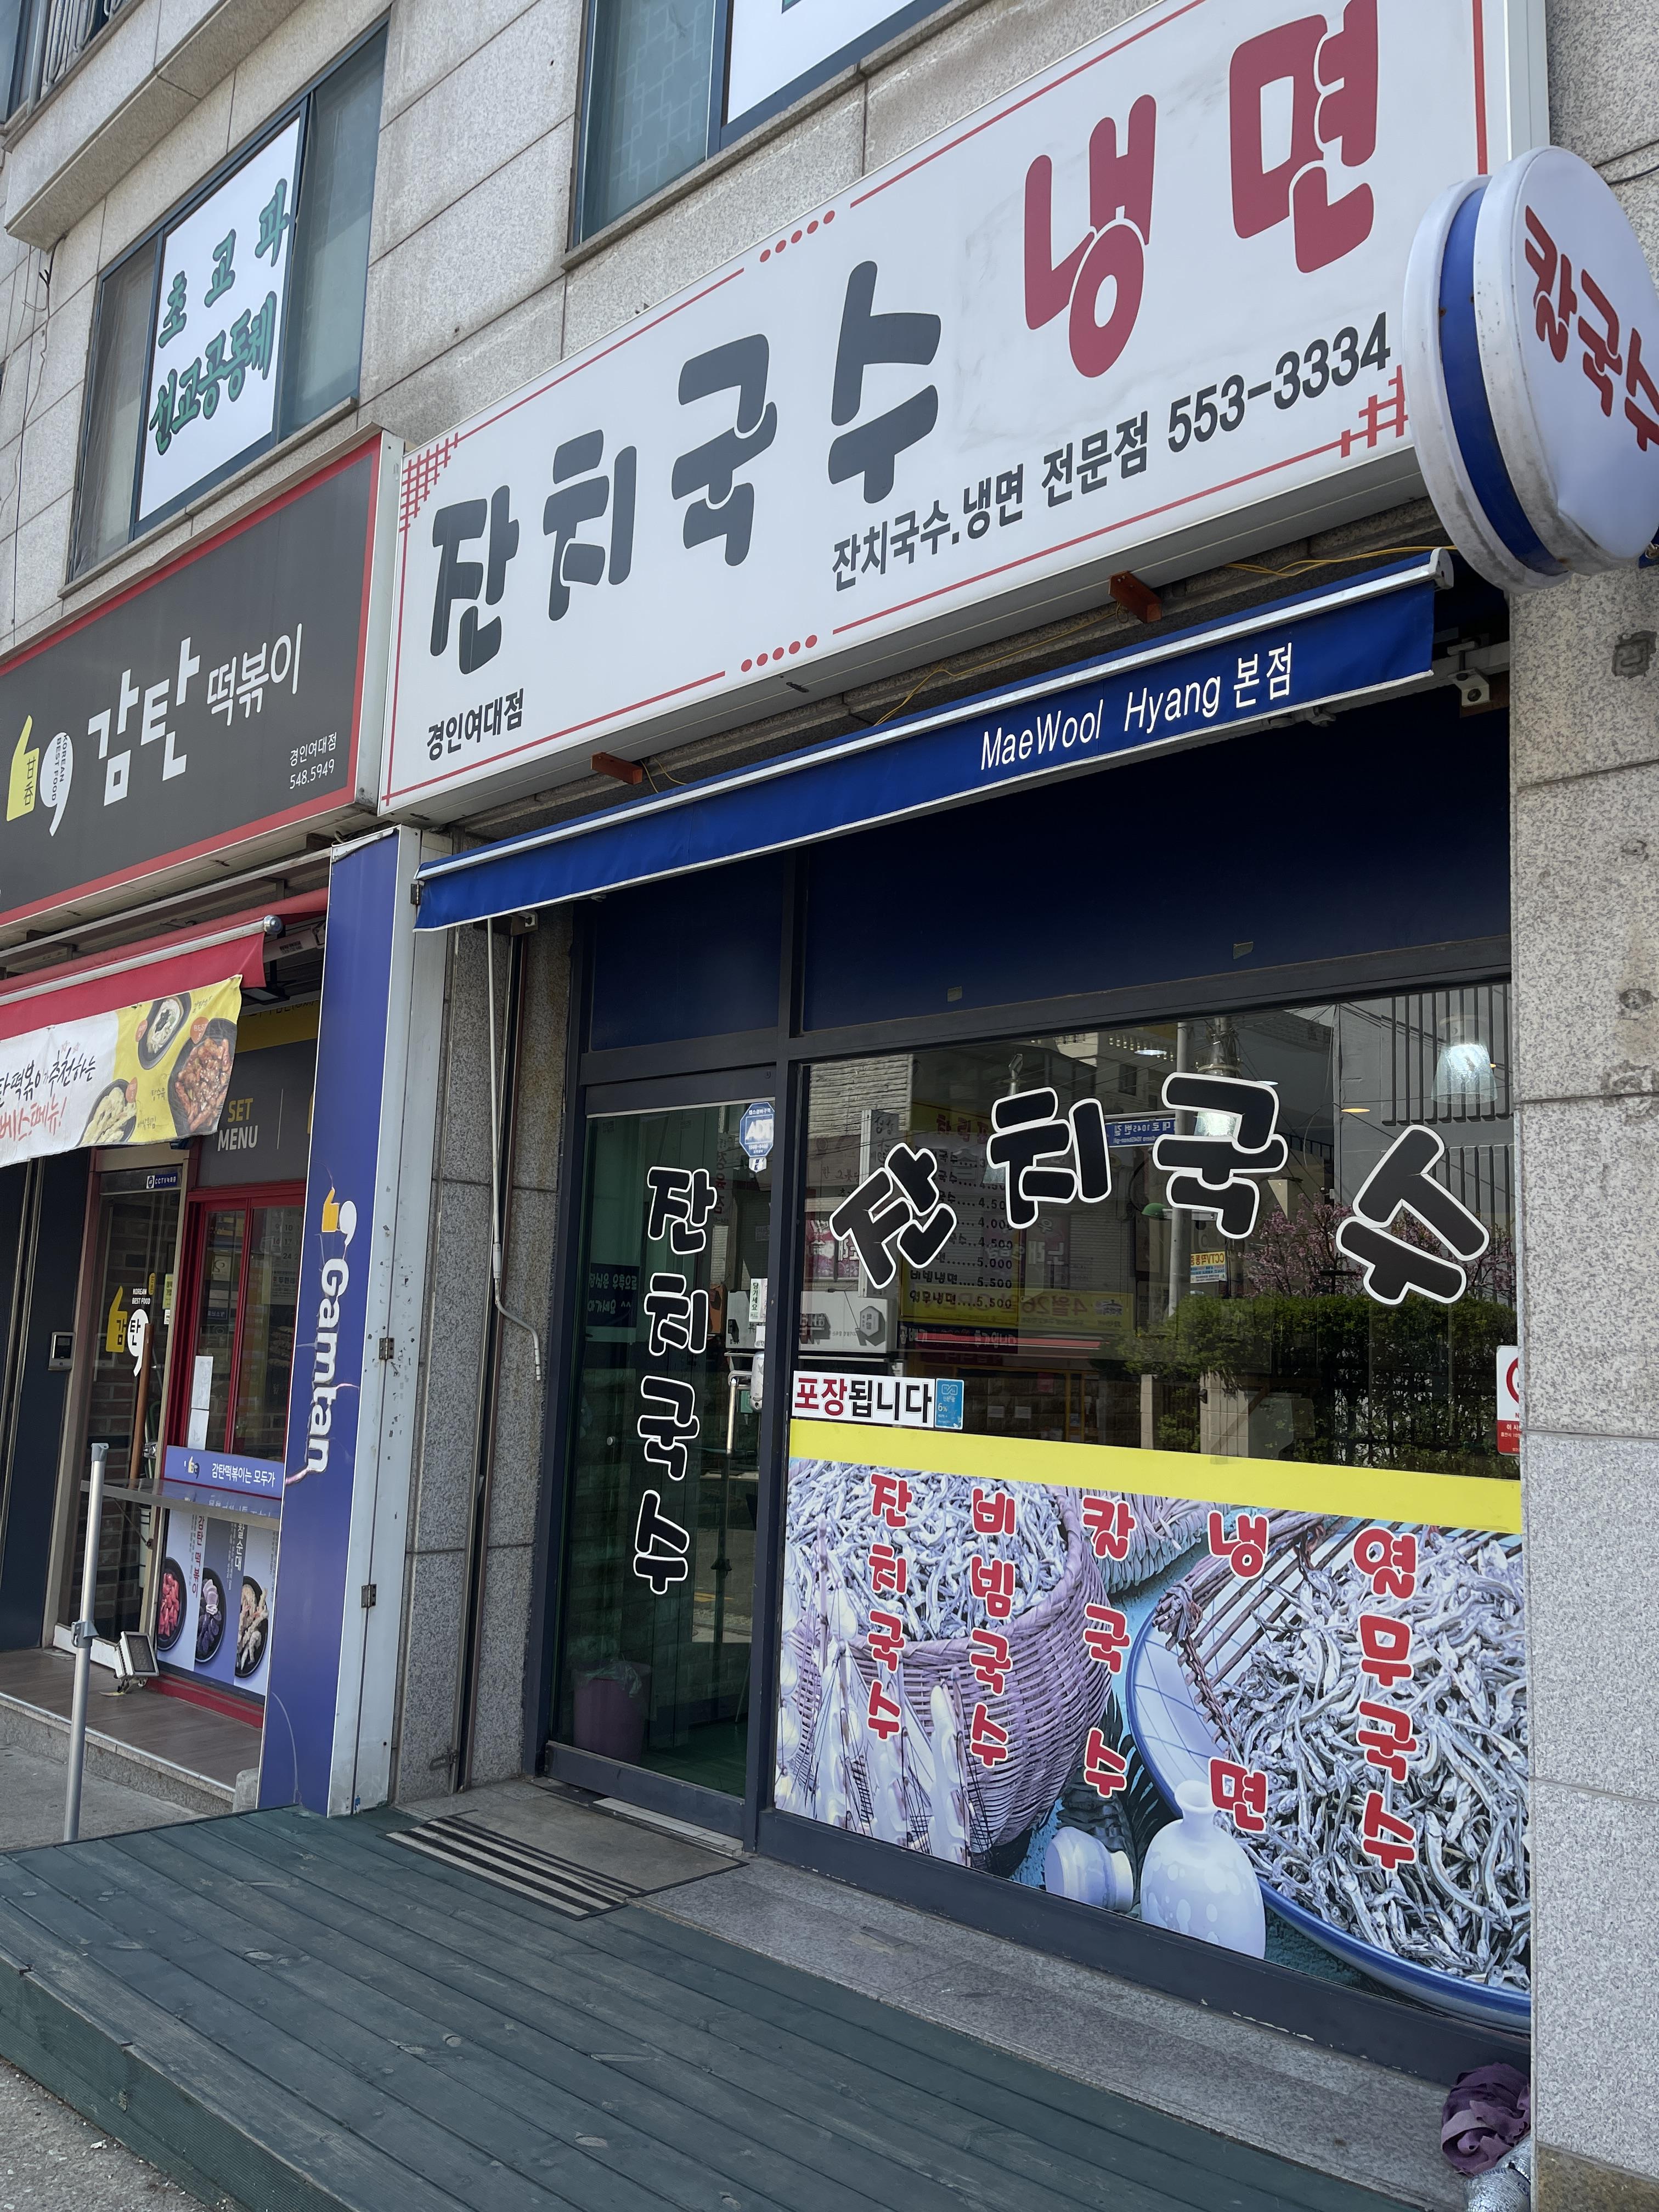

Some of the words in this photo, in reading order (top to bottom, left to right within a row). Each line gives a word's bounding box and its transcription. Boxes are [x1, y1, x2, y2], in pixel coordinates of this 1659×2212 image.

[1024, 0, 1379, 378] 냉면
[150, 290, 277, 455] 선교공동체
[1525, 204, 1659, 452] 칼국수
[430, 261, 941, 674] 잔치국수
[1040, 411, 1149, 507] 전문점
[1167, 311, 1392, 455] 553-3334
[59, 734, 69, 783] KOREAN
[88, 636, 200, 806] 감탄
[207, 623, 303, 726] 떡볶이
[290, 732, 337, 767] 경인여대점
[426, 689, 524, 761] 경인여대점
[980, 698, 1104, 770] MaeWool
[1123, 673, 1221, 735] Hyang
[1233, 641, 1294, 708] 본점
[290, 759, 335, 789] 548.5949
[49, 1047, 96, 1097] 추천하는
[228, 1098, 254, 1122] SET
[217, 1125, 258, 1152] MENU
[829, 1073, 1489, 1305] 잔치국수
[116, 1318, 142, 1346] 감탄
[612, 1273, 637, 1290] 우측으로
[751, 1282, 759, 1311] 당기세요
[308, 1259, 349, 1474] Gamtan
[633, 1166, 718, 1594] 잔치국수
[794, 1378, 932, 1423] 포장됩니다
[197, 1516, 205, 1546] 감탄
[212, 1463, 252, 1485] 감탄떡볶이는
[253, 1470, 275, 1488] 모두가
[193, 1551, 201, 1598] 떡볶이
[867, 1472, 912, 1741] 잔치국수
[969, 1487, 1016, 1768] 비빔국수
[1082, 1496, 1136, 1798] 칼국수
[1207, 1510, 1269, 1833] 냉면
[1353, 1527, 1419, 1871] 열무국수
